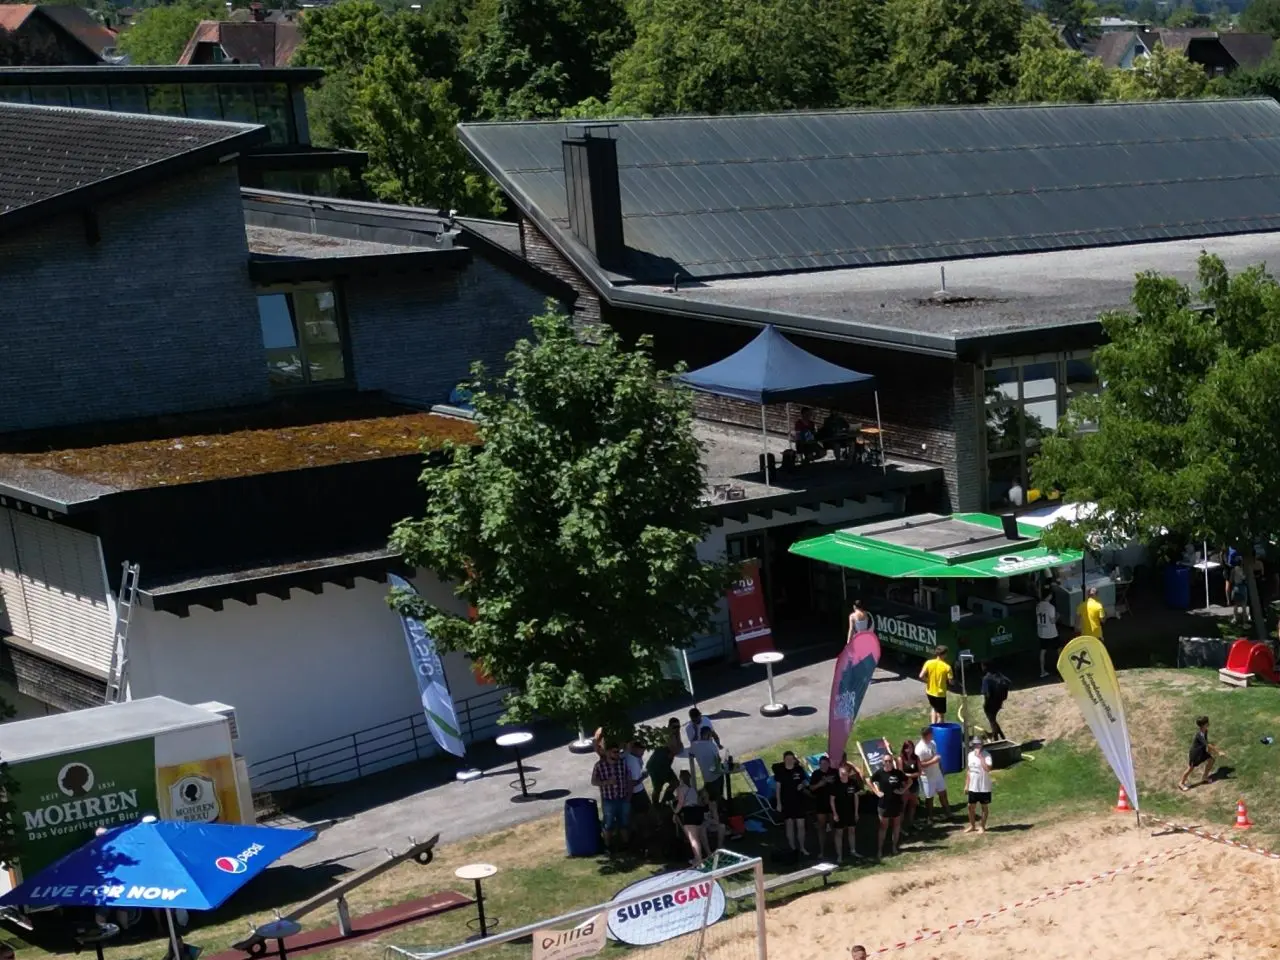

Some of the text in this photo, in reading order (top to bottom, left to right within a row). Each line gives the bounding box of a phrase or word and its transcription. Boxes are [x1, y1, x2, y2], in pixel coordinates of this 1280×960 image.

[876, 614, 937, 646] MOHREN
[22, 788, 138, 830] MOHREN
[175, 803, 214, 816] MOHREN
[28, 811, 140, 841] Das Vorarlberger Bier
[236, 842, 265, 863] pepsi
[30, 885, 77, 898] LIVE
[80, 885, 125, 898] FOR
[616, 882, 712, 923] SUPERGAU
